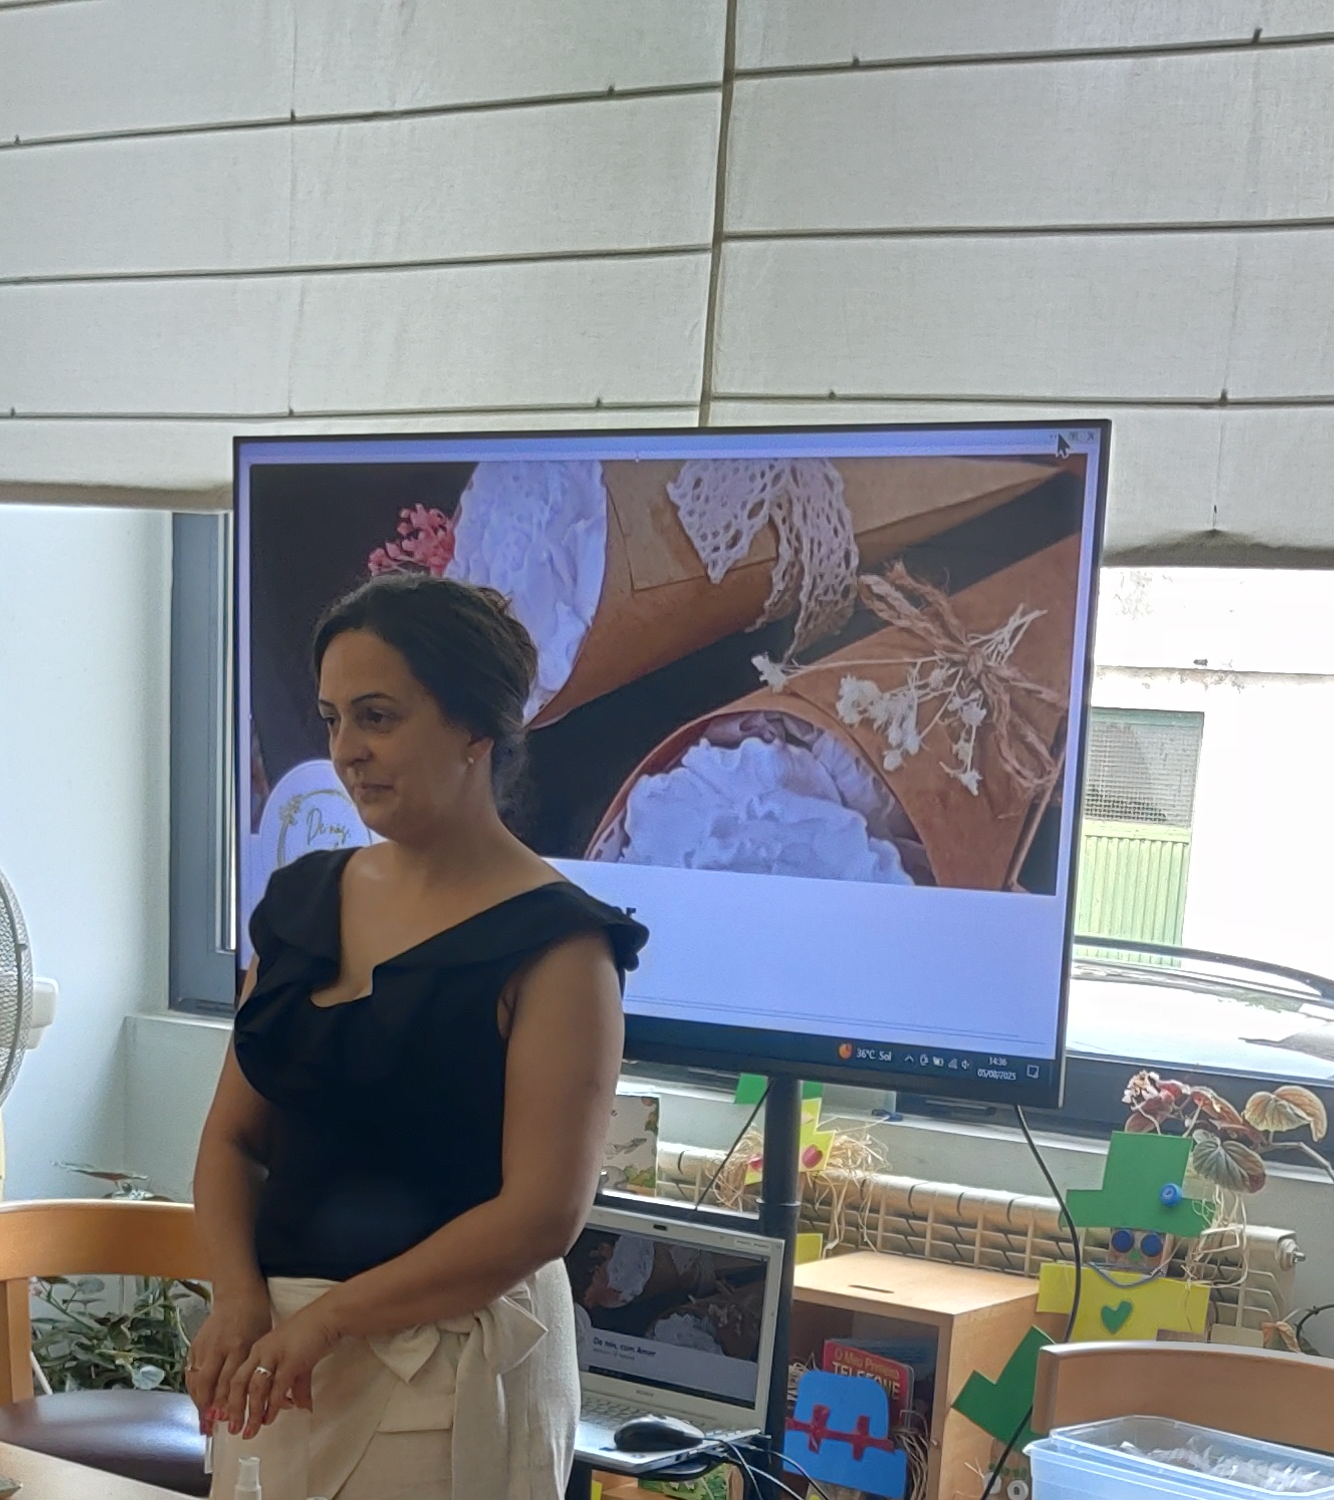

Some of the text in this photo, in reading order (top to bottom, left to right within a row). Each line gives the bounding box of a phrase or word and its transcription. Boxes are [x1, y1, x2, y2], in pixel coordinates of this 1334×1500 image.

[856, 1047, 892, 1062] 36°C Sol
[988, 1056, 1008, 1067] 14:36
[976, 1068, 1017, 1081] 05/08/2025
[834, 1347, 900, 1380] O Meu Primeiro
